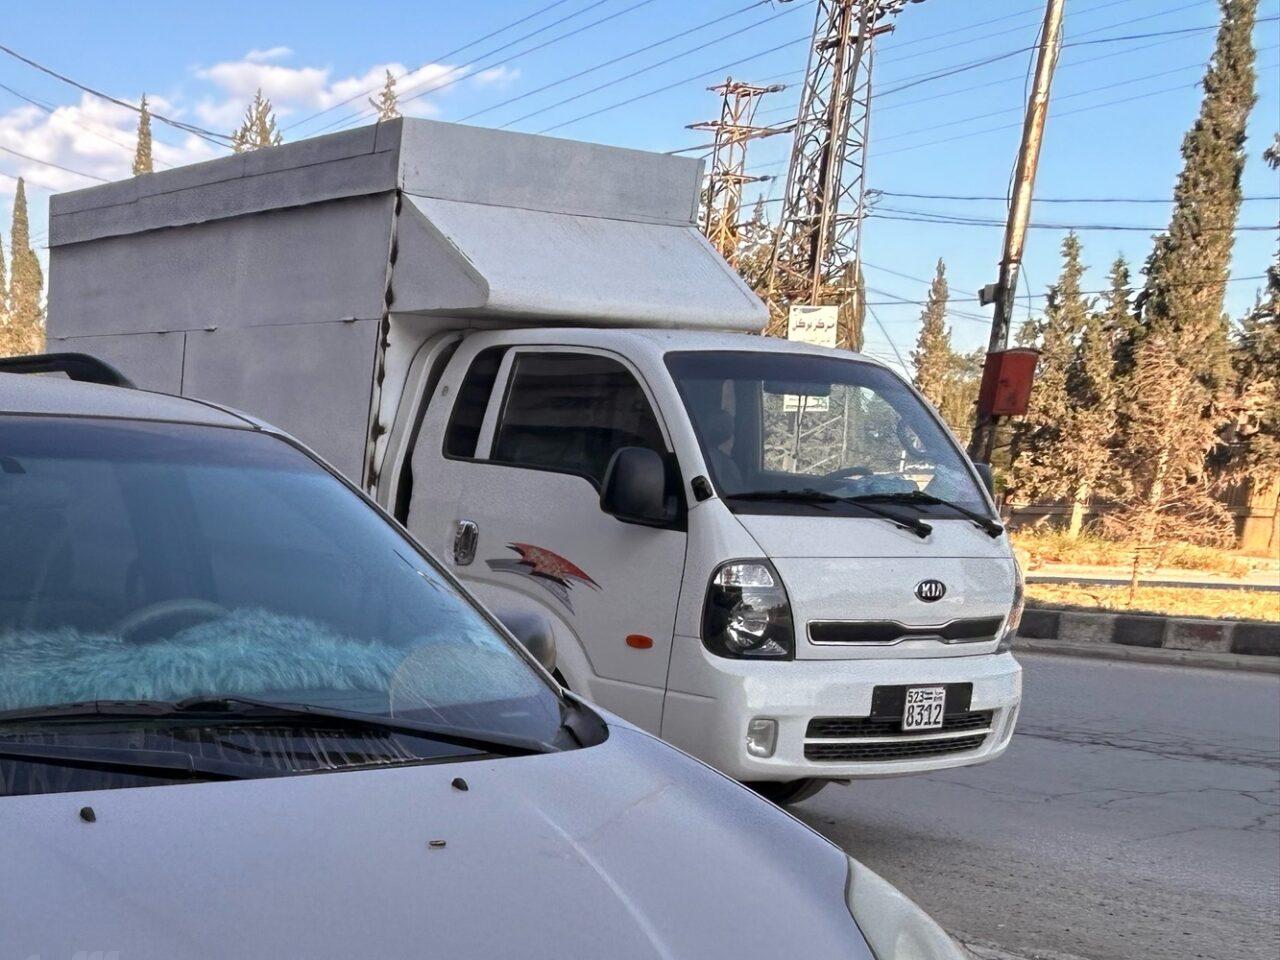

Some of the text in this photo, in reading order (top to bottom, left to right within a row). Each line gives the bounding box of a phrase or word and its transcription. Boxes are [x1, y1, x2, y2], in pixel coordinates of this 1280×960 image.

[921, 582, 943, 597] KIA
[907, 690, 925, 704] 523
[906, 703, 942, 728] 8312
